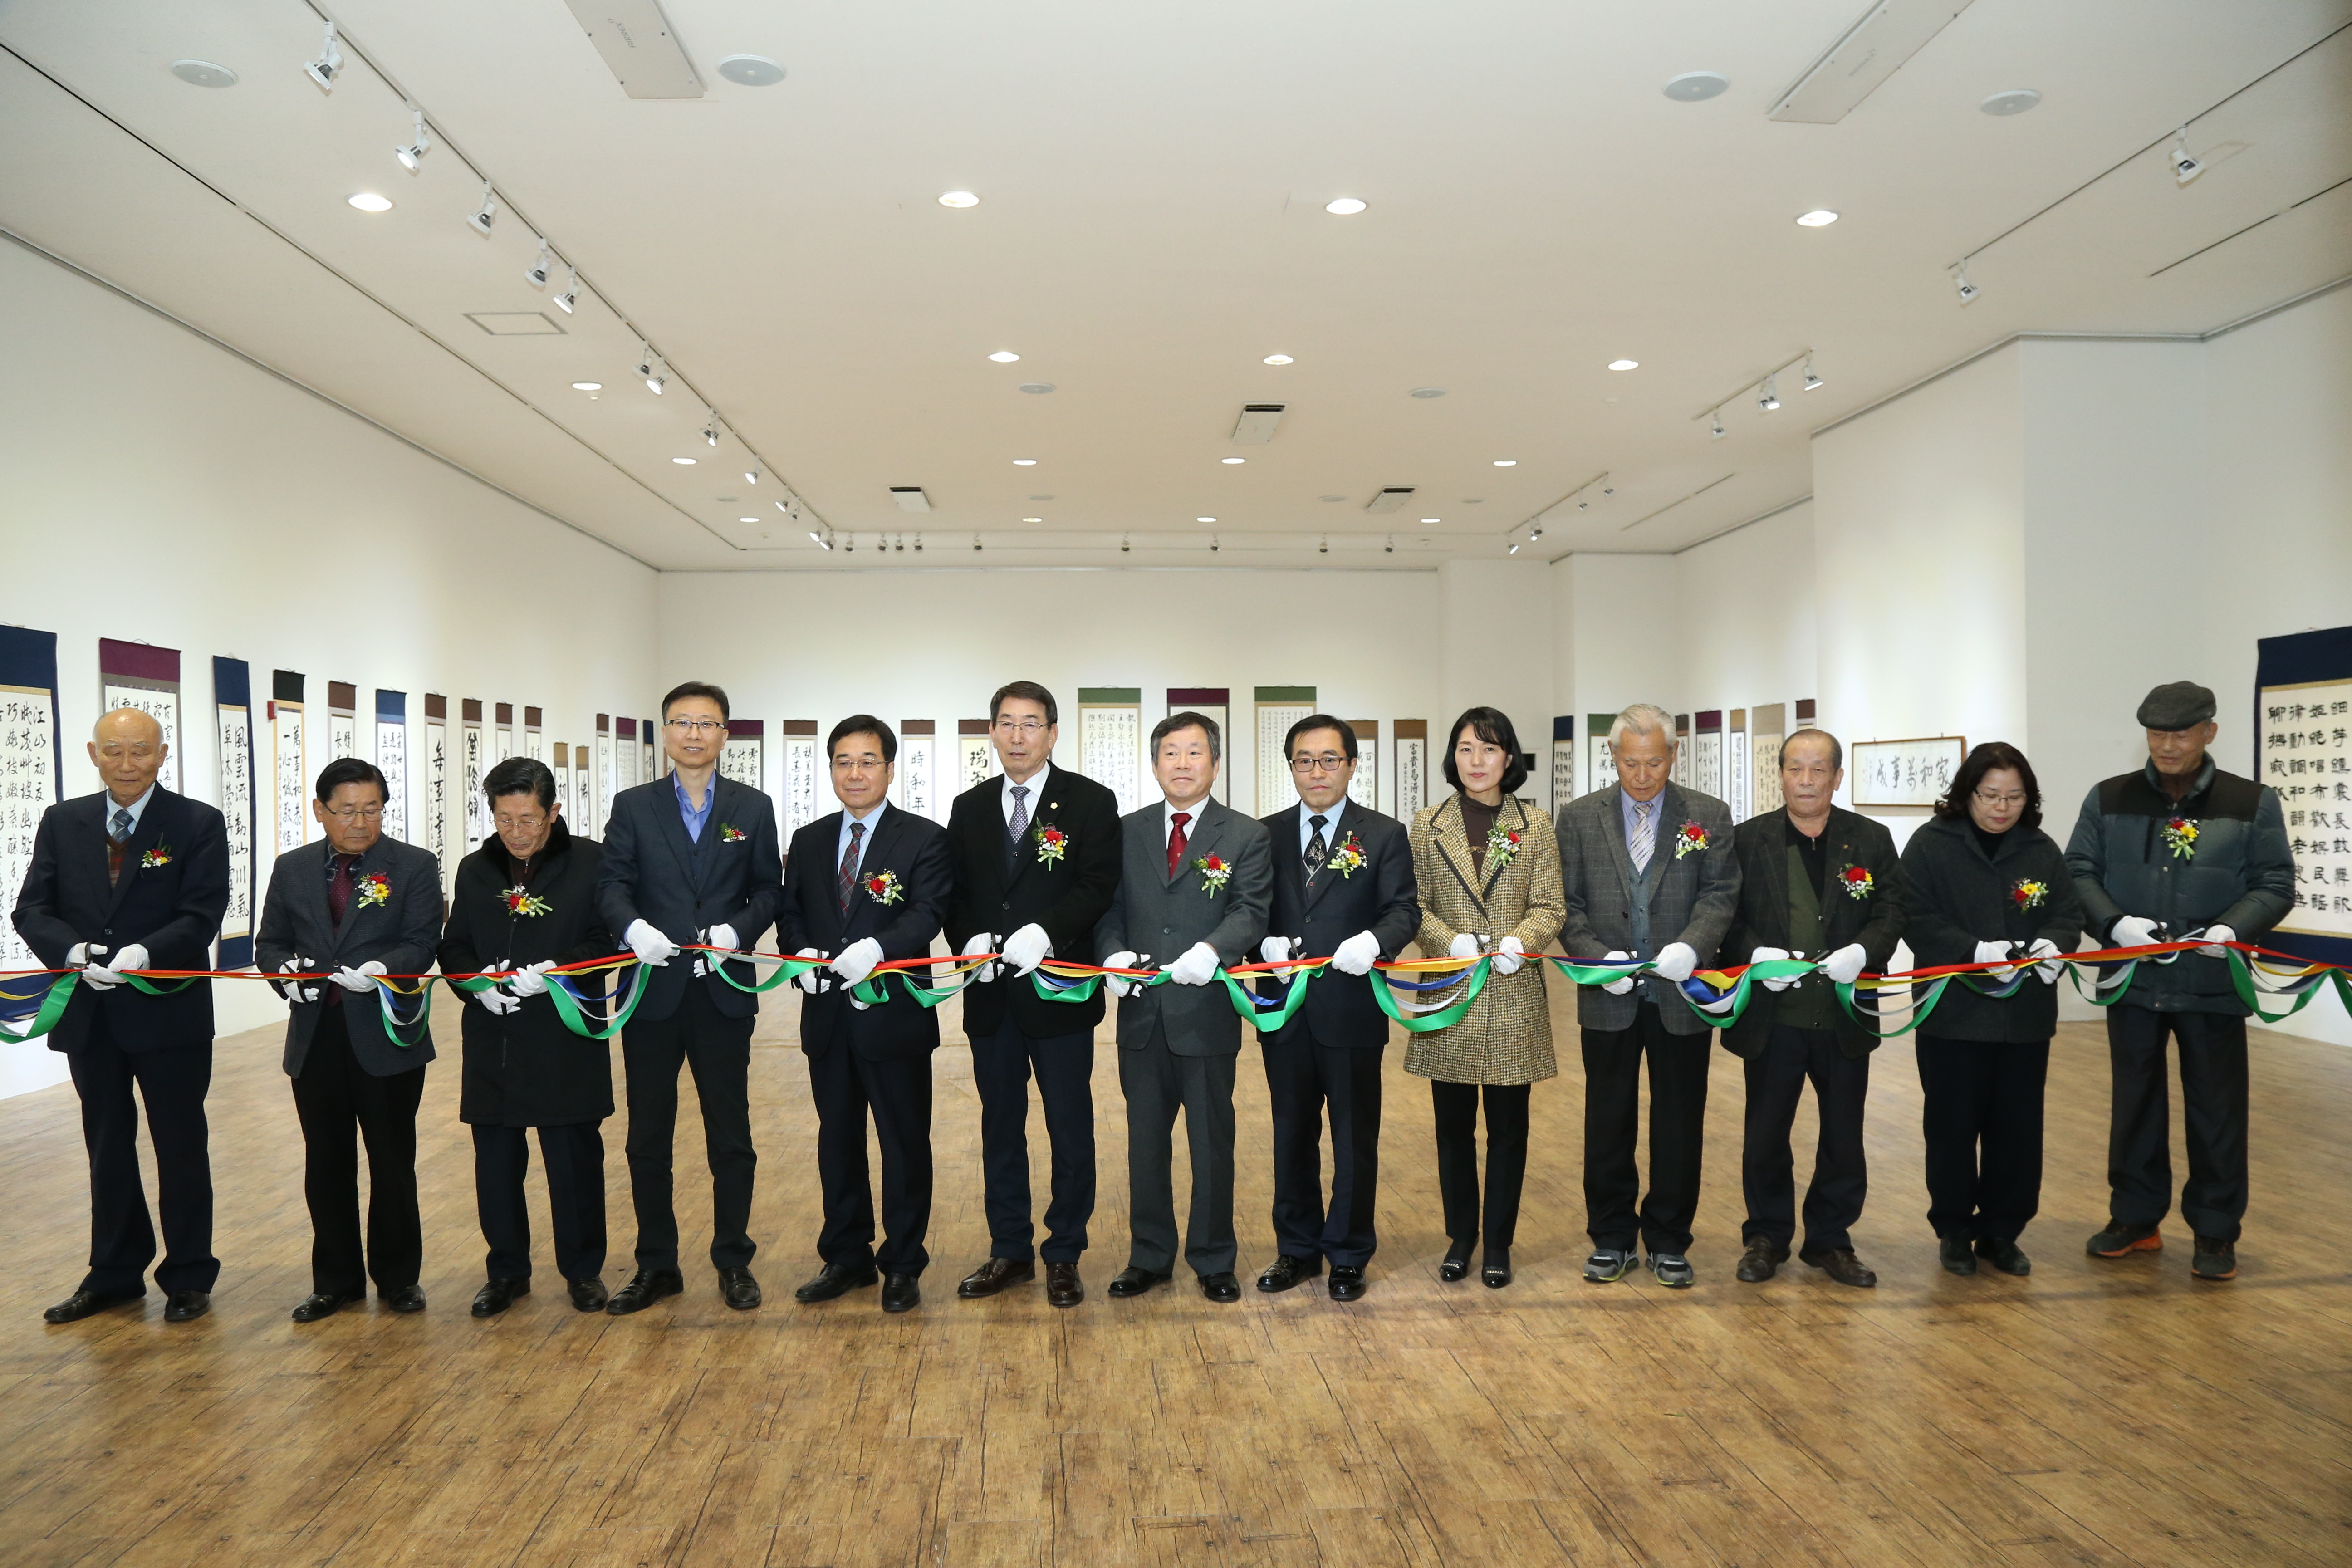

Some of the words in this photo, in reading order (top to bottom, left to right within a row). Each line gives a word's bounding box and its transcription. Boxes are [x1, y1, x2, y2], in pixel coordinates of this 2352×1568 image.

[616, 23, 636, 47] AIRREX
[910, 750, 926, 813] 時和年
